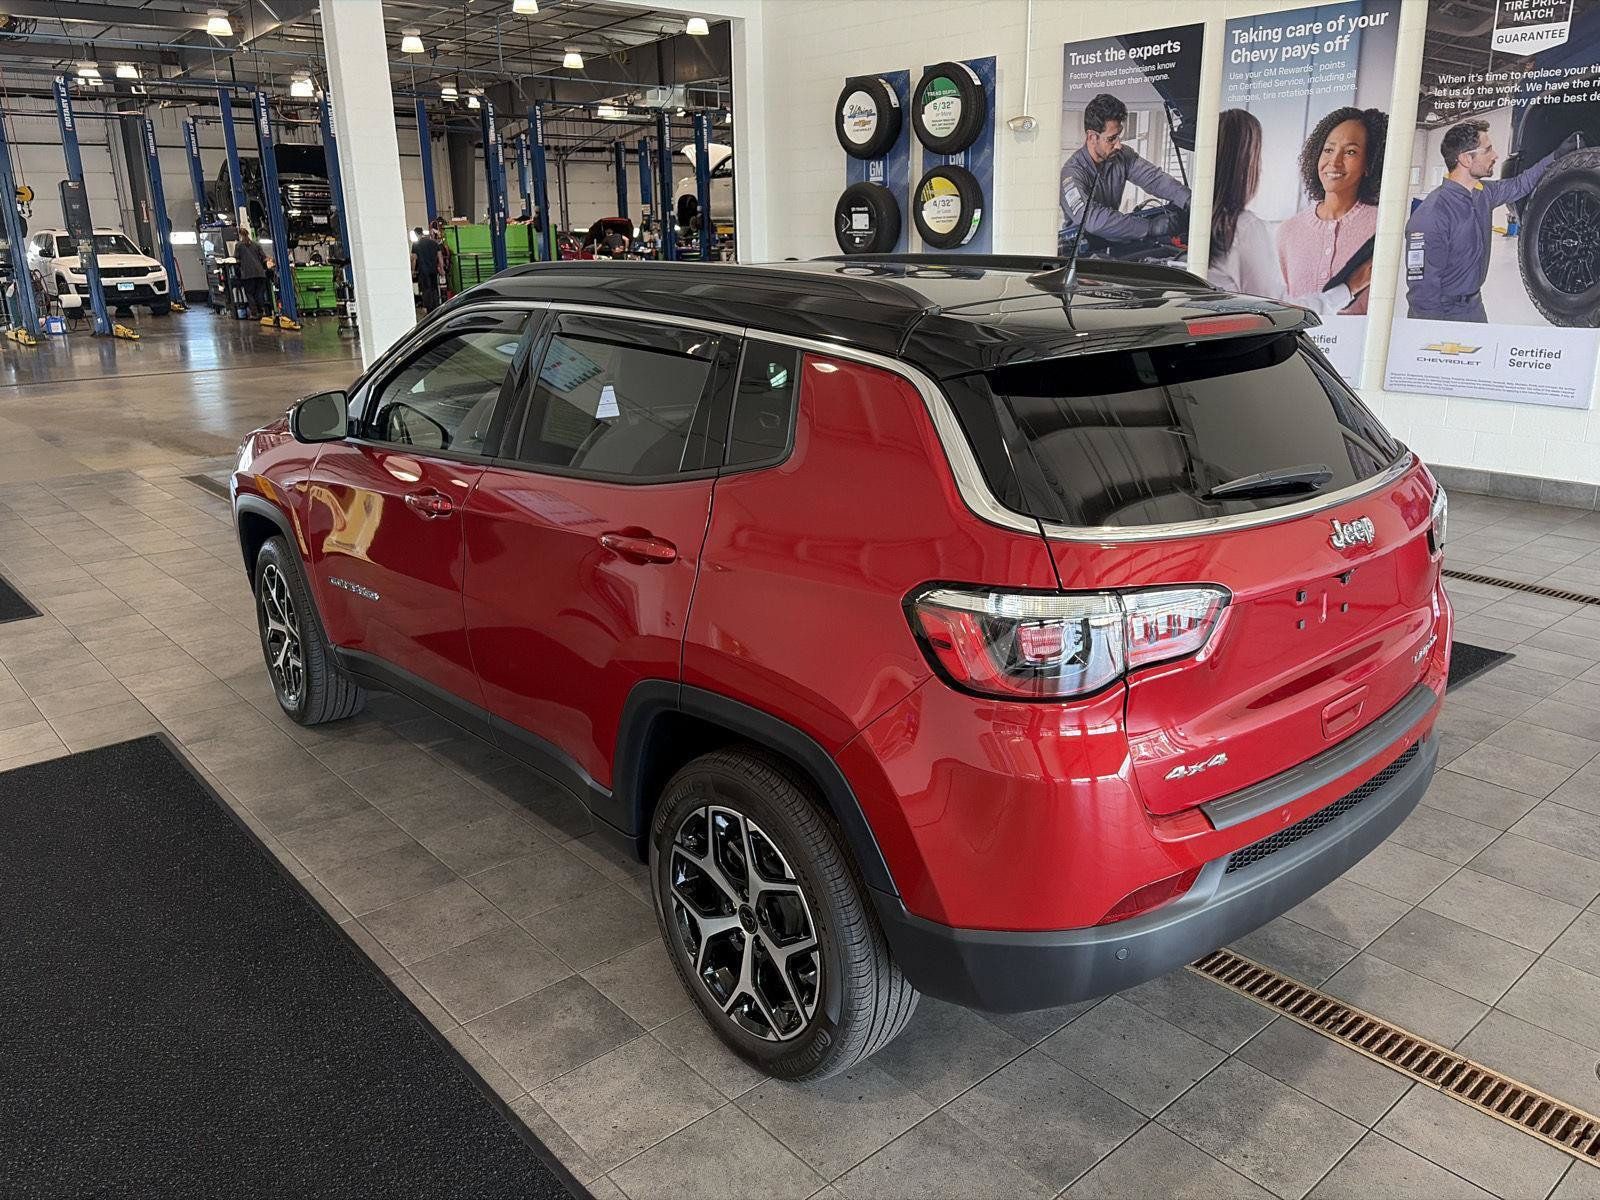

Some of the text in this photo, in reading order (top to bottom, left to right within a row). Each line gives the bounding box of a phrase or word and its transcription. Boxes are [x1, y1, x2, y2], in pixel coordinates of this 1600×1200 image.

[1504, 0, 1530, 11] TIRE
[1513, 8, 1554, 22] MATCH
[1232, 12, 1389, 44] Taking care of your
[1496, 28, 1566, 44] GUARANTEE
[1070, 40, 1180, 66] Trust the experts
[1231, 34, 1351, 64] Chevy pays off
[1070, 61, 1176, 80] Factory-trained technicians know
[1229, 72, 1244, 80] Use
[1245, 71, 1262, 80] your
[1264, 68, 1277, 78] GM
[1319, 61, 1346, 71] points
[1240, 80, 1272, 90] Certified
[1274, 76, 1306, 88] Service,
[1307, 72, 1346, 86] including
[1346, 70, 1356, 79] oil
[1438, 64, 1600, 84] When it's time to replace your ti
[1069, 74, 1170, 91] your vehicle better than anyone.
[1434, 87, 1447, 97] let
[1449, 86, 1460, 96] us
[1462, 85, 1475, 96] do
[1477, 84, 1494, 94] the
[1496, 82, 1522, 94] work.
[1526, 82, 1542, 92] We
[1544, 80, 1570, 90] have
[1572, 78, 1590, 88] the
[1228, 82, 1358, 103] changes, tire rotations and more.
[1434, 98, 1455, 110] tires
[1458, 98, 1470, 108] for
[1474, 98, 1495, 112] your
[1497, 96, 1528, 108] Chevy
[1530, 96, 1541, 105] at
[1544, 94, 1560, 104] the
[1562, 92, 1588, 102] best
[61, 98, 72, 128] ROTARY
[258, 92, 270, 136] ROTARY LIFT
[870, 161, 884, 176] GM
[1416, 356, 1482, 366] CHEVROLET
[1510, 347, 1562, 359] Certified
[1508, 358, 1552, 370] Service
[1330, 516, 1376, 550] Jeep
[1164, 752, 1228, 781] 4x4
